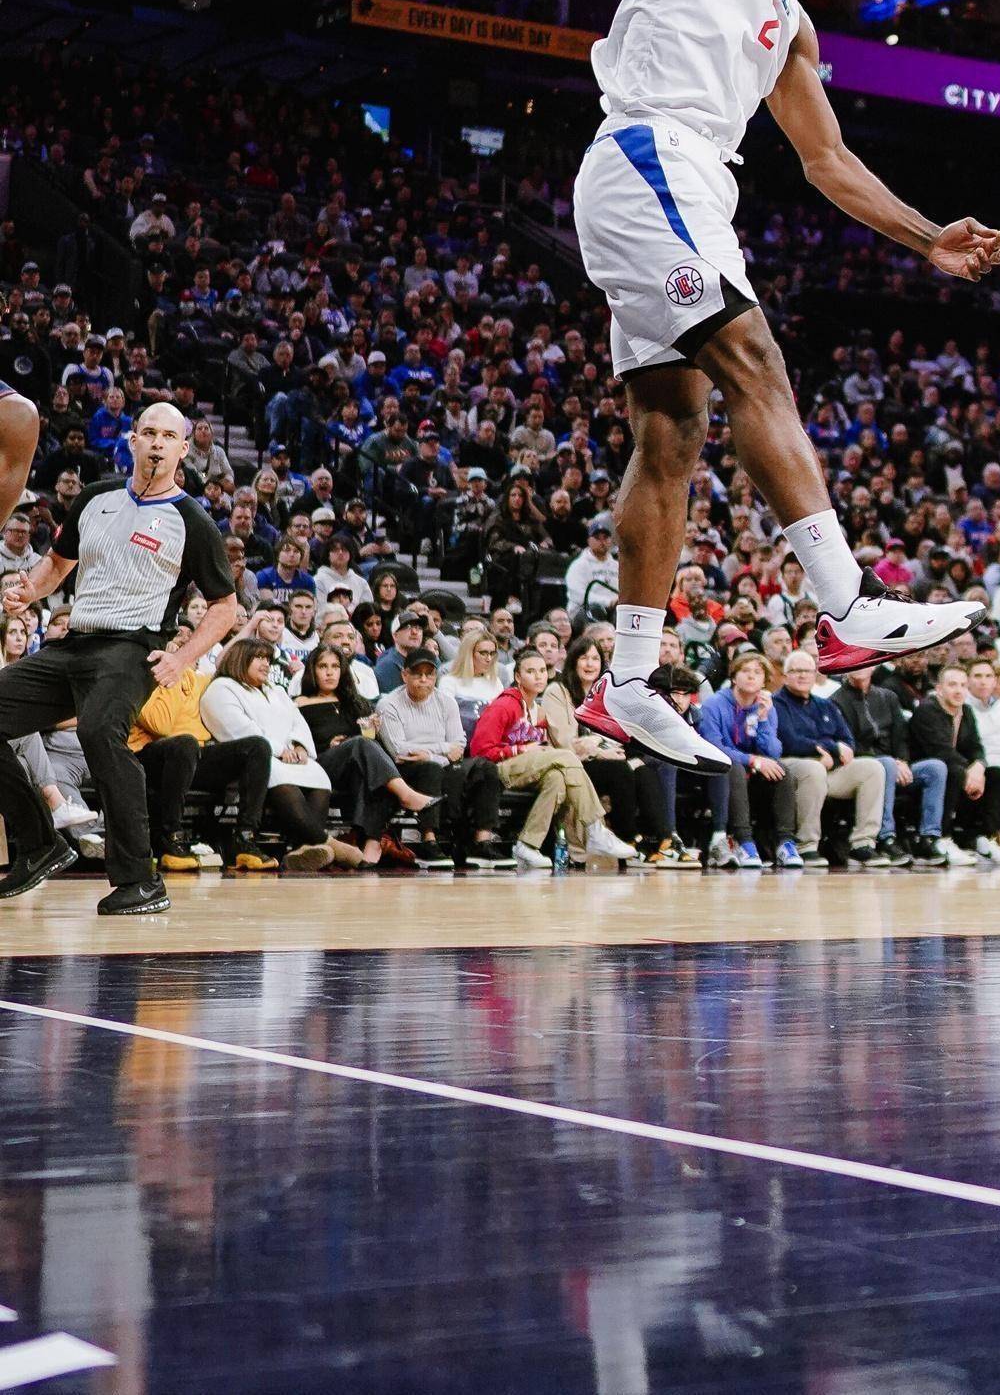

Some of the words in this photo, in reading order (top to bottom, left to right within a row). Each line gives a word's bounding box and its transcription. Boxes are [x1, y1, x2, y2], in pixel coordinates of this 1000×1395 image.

[408, 8, 446, 29] EVERY
[450, 15, 474, 35] DAY
[476, 19, 488, 38] IS
[492, 23, 525, 43] GAME
[529, 28, 552, 47] DAY
[944, 84, 1000, 113] CITY
[133, 534, 158, 550] Emirates
